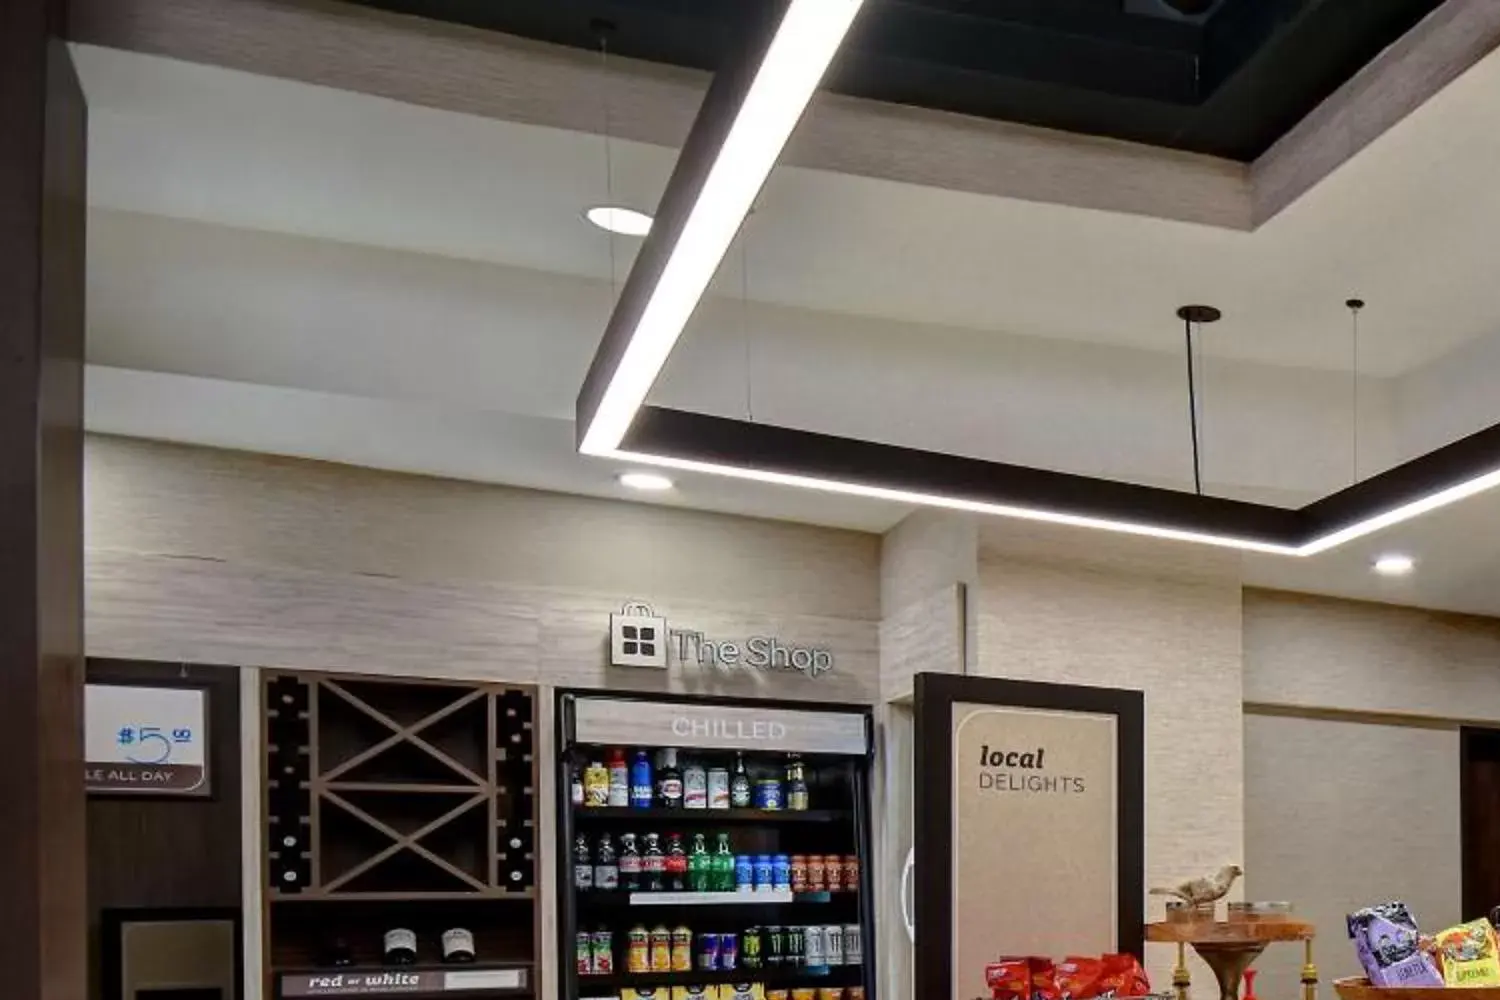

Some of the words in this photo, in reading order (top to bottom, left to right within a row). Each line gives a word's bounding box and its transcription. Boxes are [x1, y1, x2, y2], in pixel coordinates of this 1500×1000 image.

[671, 629, 740, 664] The
[745, 636, 833, 678] Shop
[671, 716, 787, 740] CHILLED
[979, 745, 1045, 769] local
[107, 769, 136, 781] ALL
[141, 771, 174, 783] DAY
[978, 772, 1086, 793] DELIGHTS
[308, 975, 343, 988] red
[364, 972, 420, 985] white
